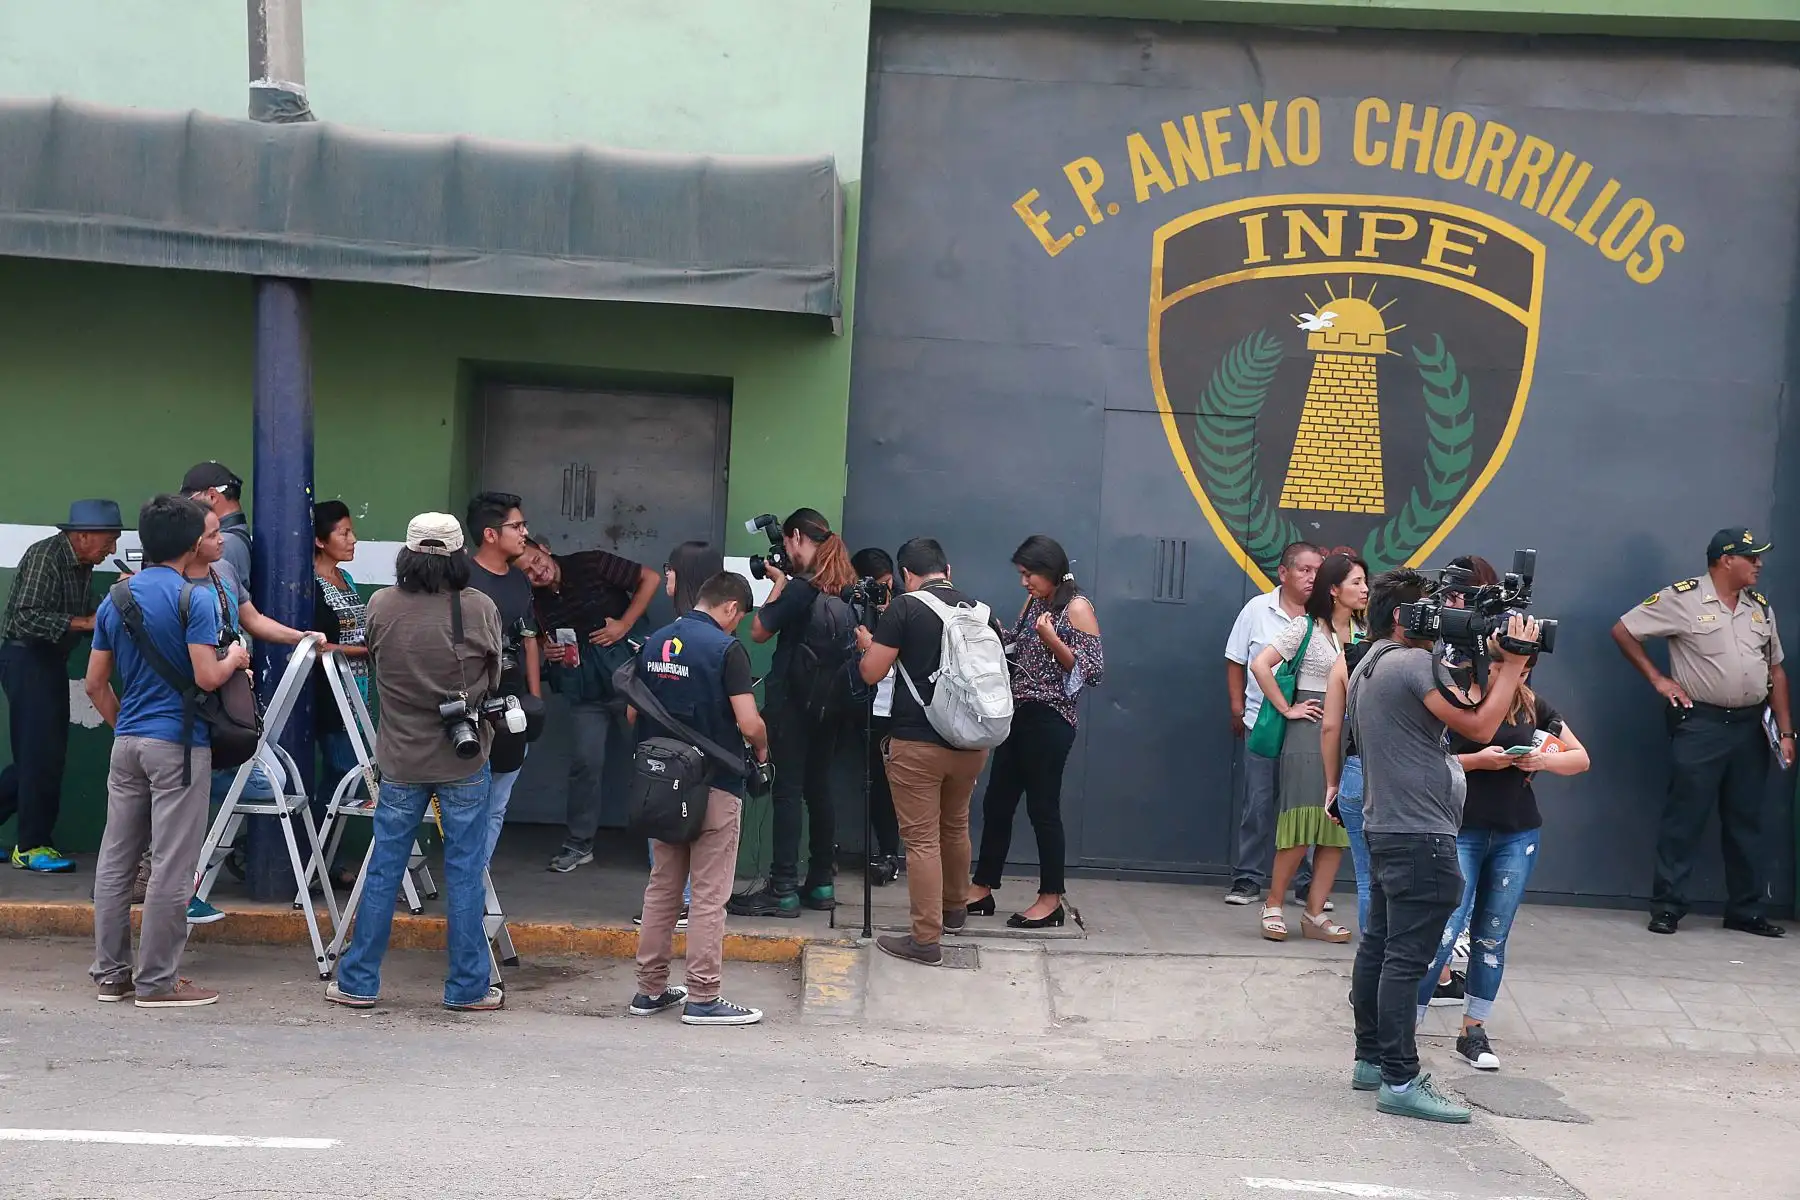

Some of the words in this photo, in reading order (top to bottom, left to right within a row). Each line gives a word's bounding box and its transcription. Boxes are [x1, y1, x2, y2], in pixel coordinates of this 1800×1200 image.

[1127, 97, 1321, 203] ANEXO
[1353, 97, 1685, 285] CHORRILLOS
[1239, 209, 1488, 277] INPE
[1476, 634, 1485, 656] SONY
[647, 661, 689, 677] PANAMERICANA
